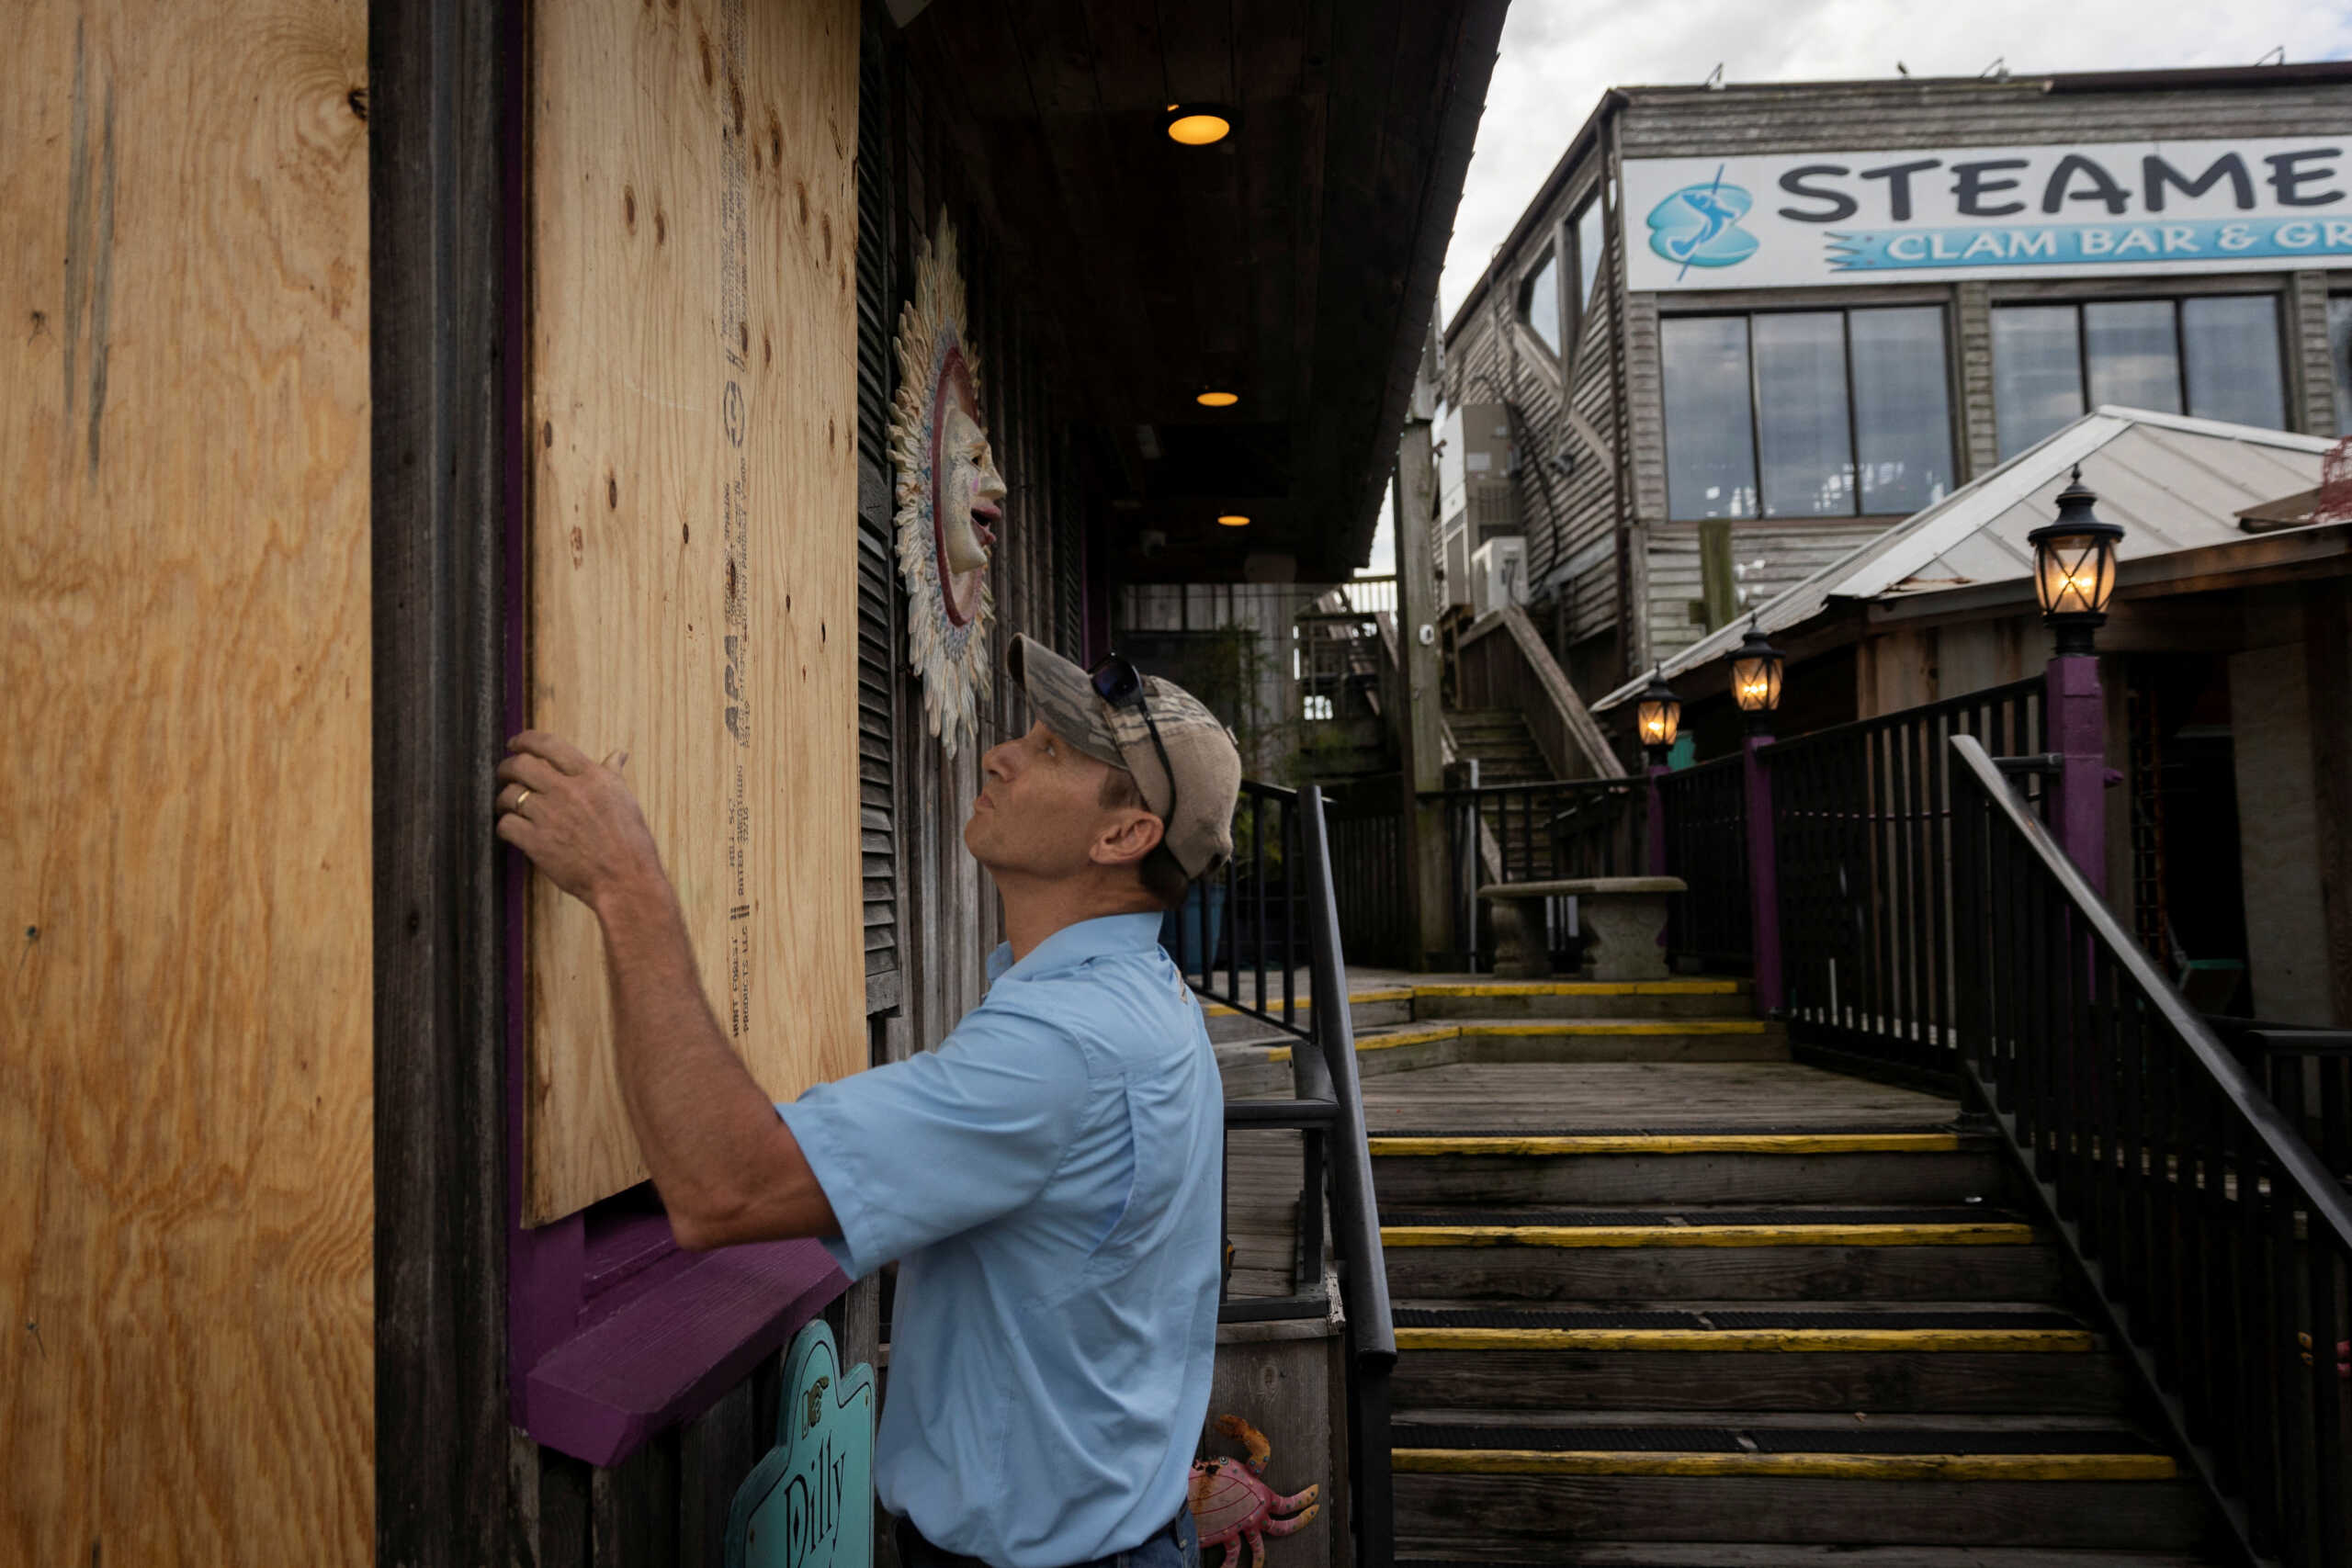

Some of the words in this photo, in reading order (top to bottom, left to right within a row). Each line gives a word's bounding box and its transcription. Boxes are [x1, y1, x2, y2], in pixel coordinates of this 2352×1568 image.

[1779, 147, 2346, 224] STEAME
[1886, 227, 2058, 263] CLAM
[2081, 224, 2201, 258] BAR
[2218, 222, 2259, 251] &
[784, 1428, 846, 1568] Dilly
